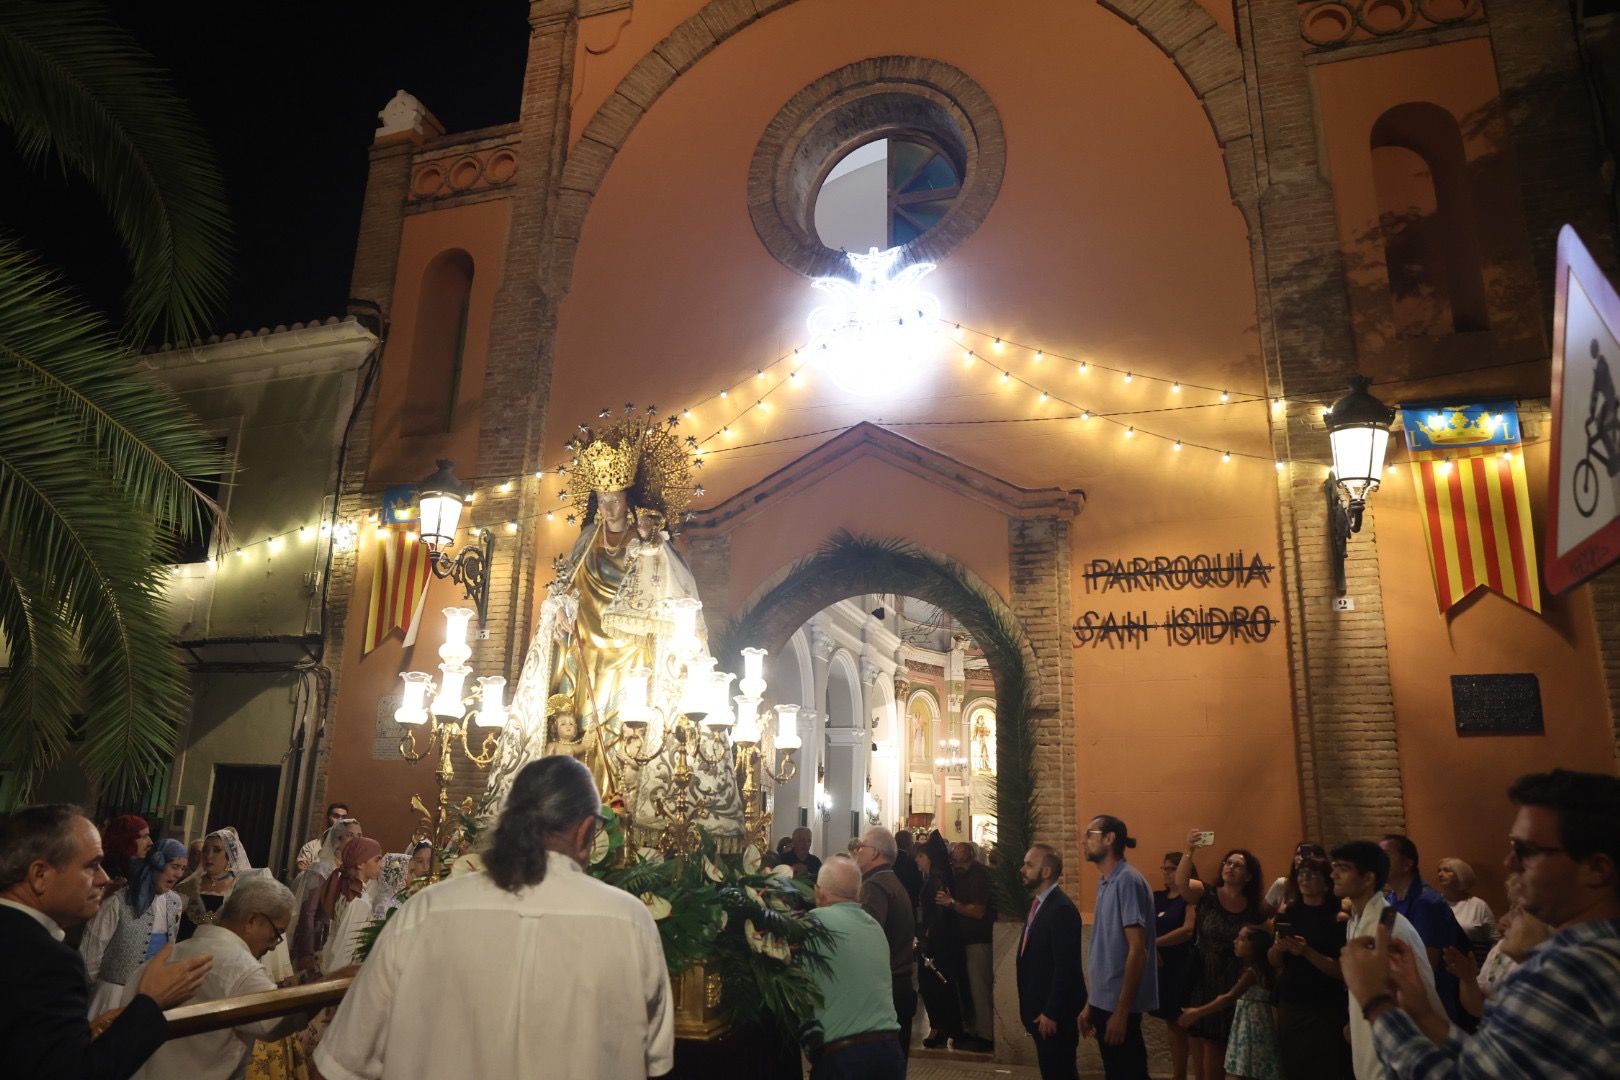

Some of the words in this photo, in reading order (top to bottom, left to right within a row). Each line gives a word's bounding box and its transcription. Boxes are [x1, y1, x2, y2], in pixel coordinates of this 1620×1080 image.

[1408, 430, 1421, 447] L
[1502, 422, 1515, 440] L
[1090, 549, 1271, 590] PARROQUIA
[1074, 610, 1149, 643] SAN
